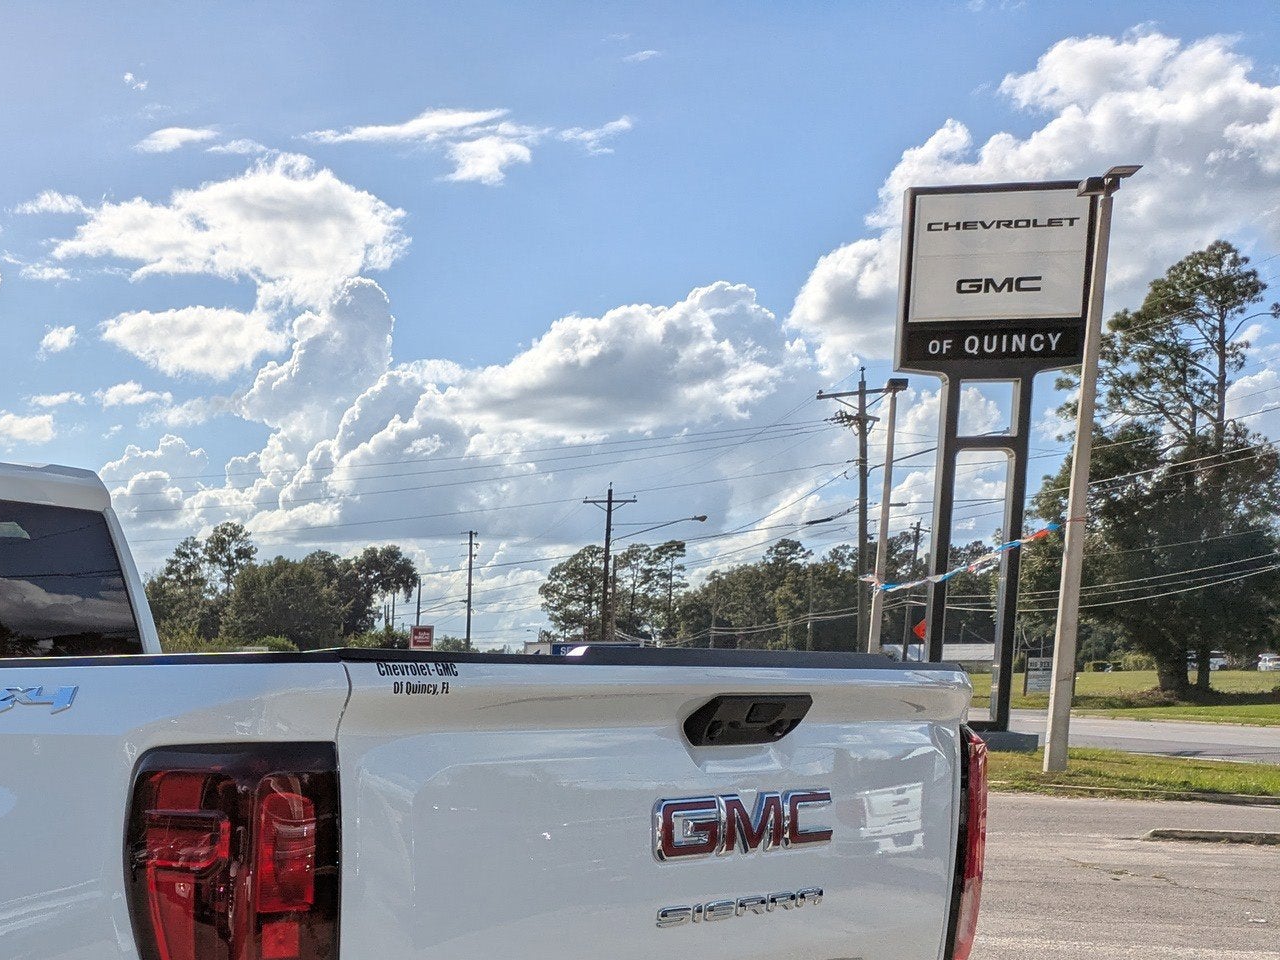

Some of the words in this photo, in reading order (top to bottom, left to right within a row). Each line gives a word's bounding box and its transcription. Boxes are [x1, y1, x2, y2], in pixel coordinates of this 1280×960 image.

[926, 217, 1081, 232] CHEVROLET
[955, 275, 1043, 295] GMC
[927, 339, 953, 355] OF
[964, 332, 1062, 355] QUINCY
[376, 662, 459, 677] Chevrolet-GMC
[405, 681, 439, 696] Quincy,
[440, 681, 450, 695] FL
[651, 787, 834, 862] GMC
[655, 887, 824, 929] SIERRA
